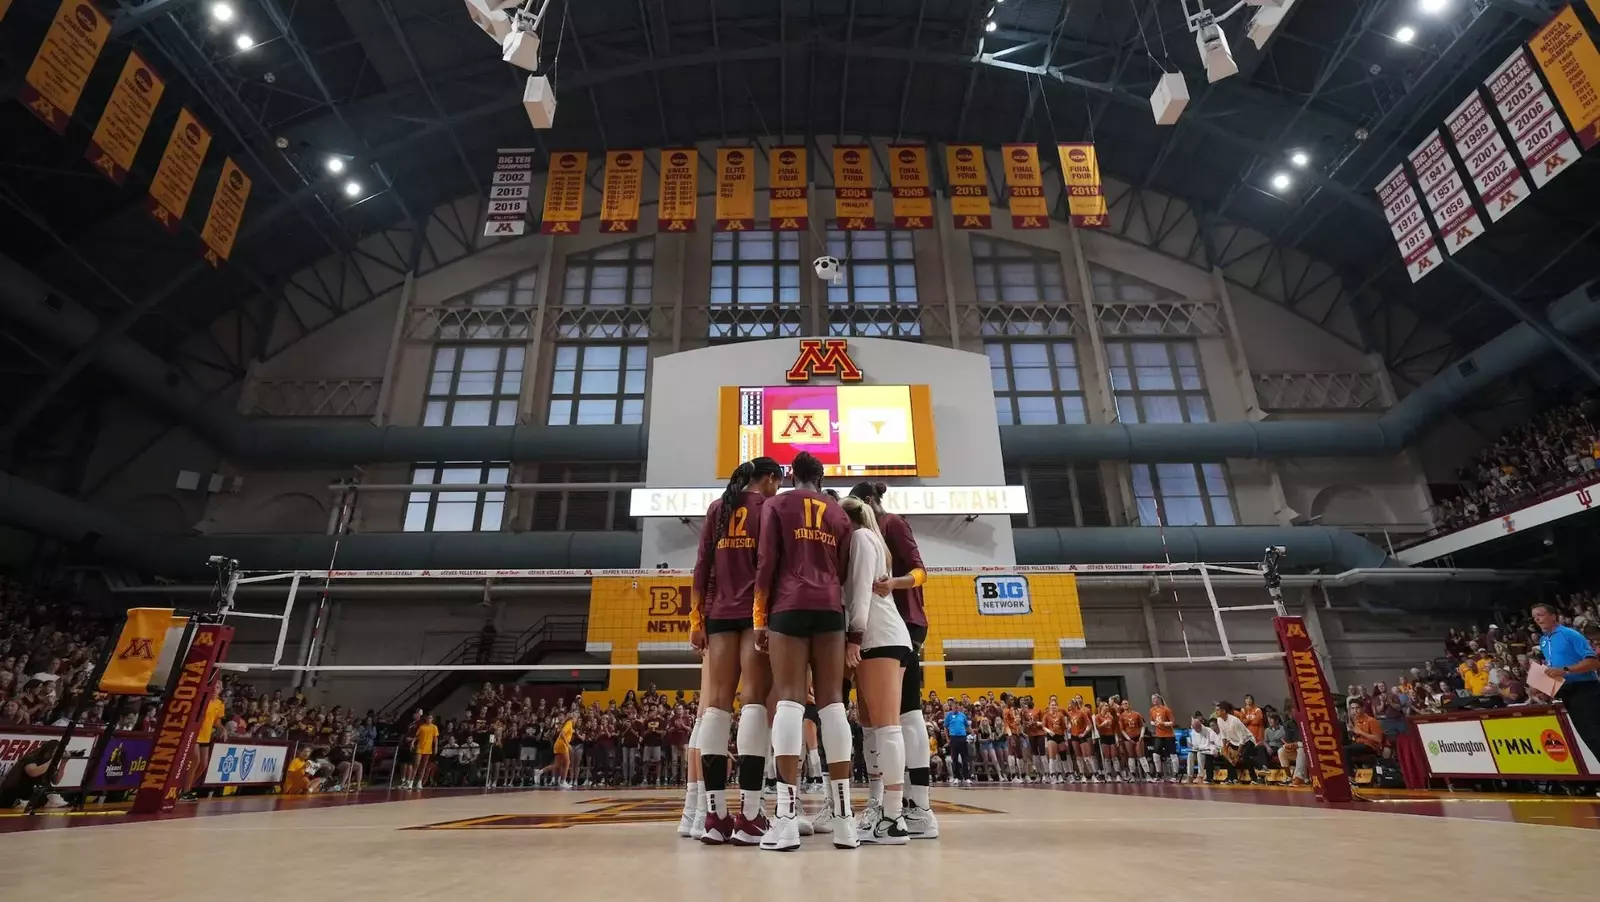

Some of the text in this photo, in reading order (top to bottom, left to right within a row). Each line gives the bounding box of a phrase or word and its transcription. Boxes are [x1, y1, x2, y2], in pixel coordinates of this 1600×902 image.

[1540, 23, 1573, 54] NATIONAL
[1543, 31, 1583, 68] CHAMPIONS
[1548, 32, 1571, 55] DUALS
[1490, 57, 1528, 93] BIG TEN
[1495, 66, 1532, 101] CHAMPIONS
[1505, 82, 1534, 113] 2003
[1450, 99, 1482, 133] BIG TEN
[1454, 108, 1486, 140] CHAMPIONS
[1515, 101, 1544, 132] 2006
[1463, 123, 1489, 150] 1999
[1525, 120, 1553, 152] 2007
[498, 155, 531, 164] BIG TEN
[1413, 139, 1442, 169] BIG TEN
[1416, 147, 1445, 176] CHAMPIONS
[1472, 142, 1498, 169] 2001
[499, 173, 525, 182] 2002
[1425, 161, 1447, 185] 1941
[1481, 160, 1508, 188] 2002
[497, 187, 522, 196] 2015
[776, 189, 802, 198] 2003
[841, 189, 867, 198] 2004
[899, 188, 924, 196] 2009
[956, 187, 981, 195] 2015
[1071, 187, 1098, 195] 2019
[1380, 172, 1406, 200] BIG TEN
[1383, 180, 1409, 206] CHAMPIONS
[1432, 179, 1455, 202] 1957
[494, 202, 520, 211] 2018
[1390, 194, 1411, 216] 1910
[1440, 197, 1464, 221] 1959
[1397, 211, 1419, 233] 1912
[1404, 229, 1426, 251] 1913
[888, 489, 1008, 510] KI-U-MAH!
[728, 506, 748, 537] 12
[804, 498, 827, 529] 17
[716, 538, 756, 549] MINNESOTA
[794, 528, 836, 547] MINNESOTA
[647, 621, 691, 633] NETW
[140, 660, 207, 790] MINNESOTA
[1292, 650, 1344, 780] MINNESOTA
[1438, 740, 1487, 756] Huntington
[261, 758, 277, 772] MN
